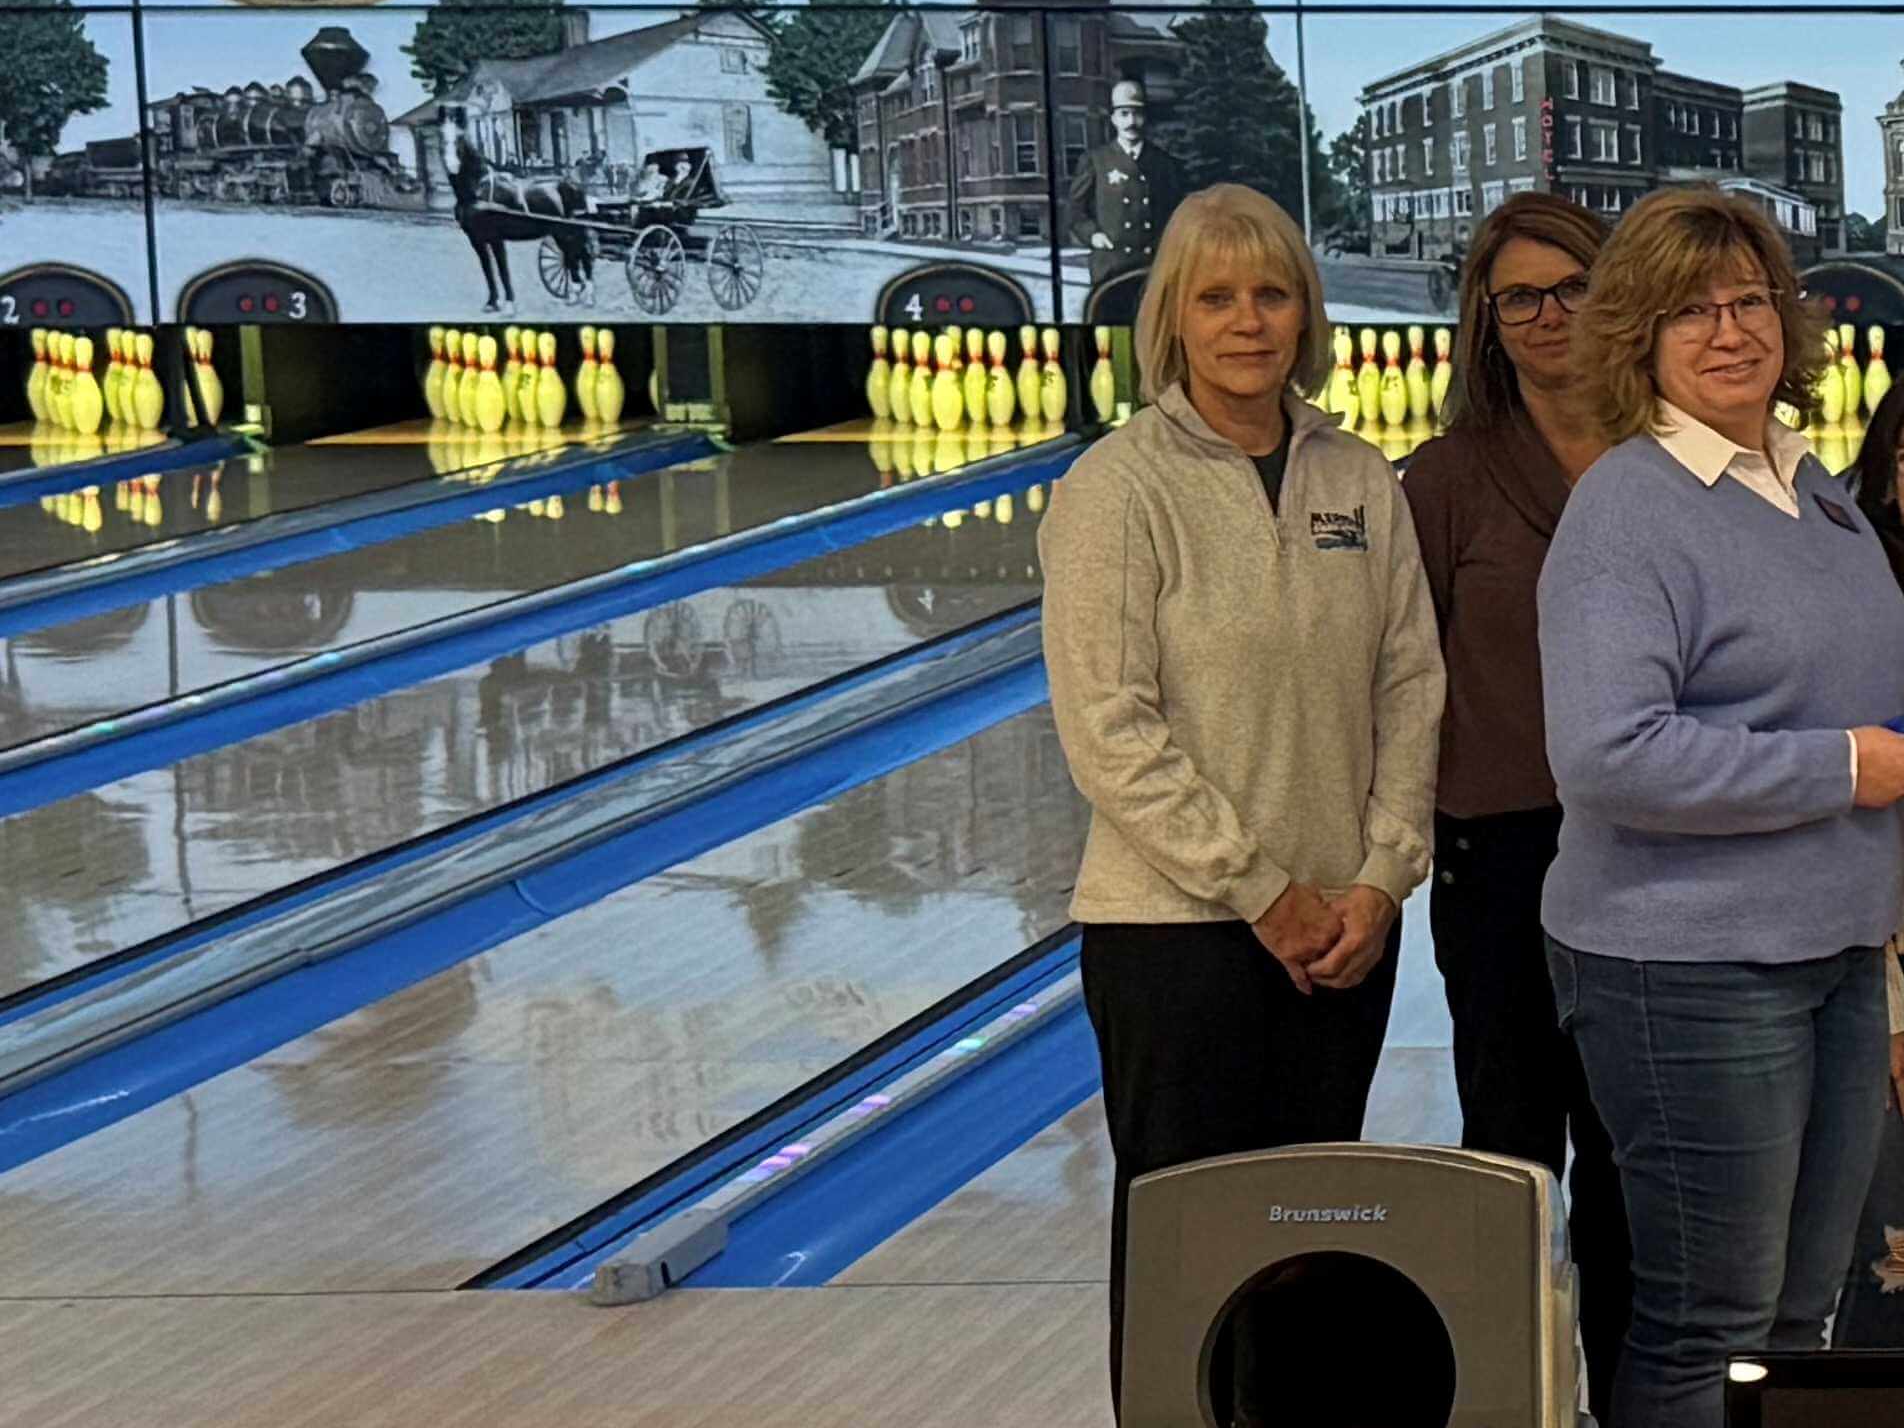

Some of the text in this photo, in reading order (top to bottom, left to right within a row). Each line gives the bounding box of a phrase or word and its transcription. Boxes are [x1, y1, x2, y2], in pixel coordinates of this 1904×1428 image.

[1, 295, 21, 325] 2
[288, 291, 307, 319] 3
[903, 292, 924, 322] 4
[1268, 1203, 1388, 1224] Brunswick
